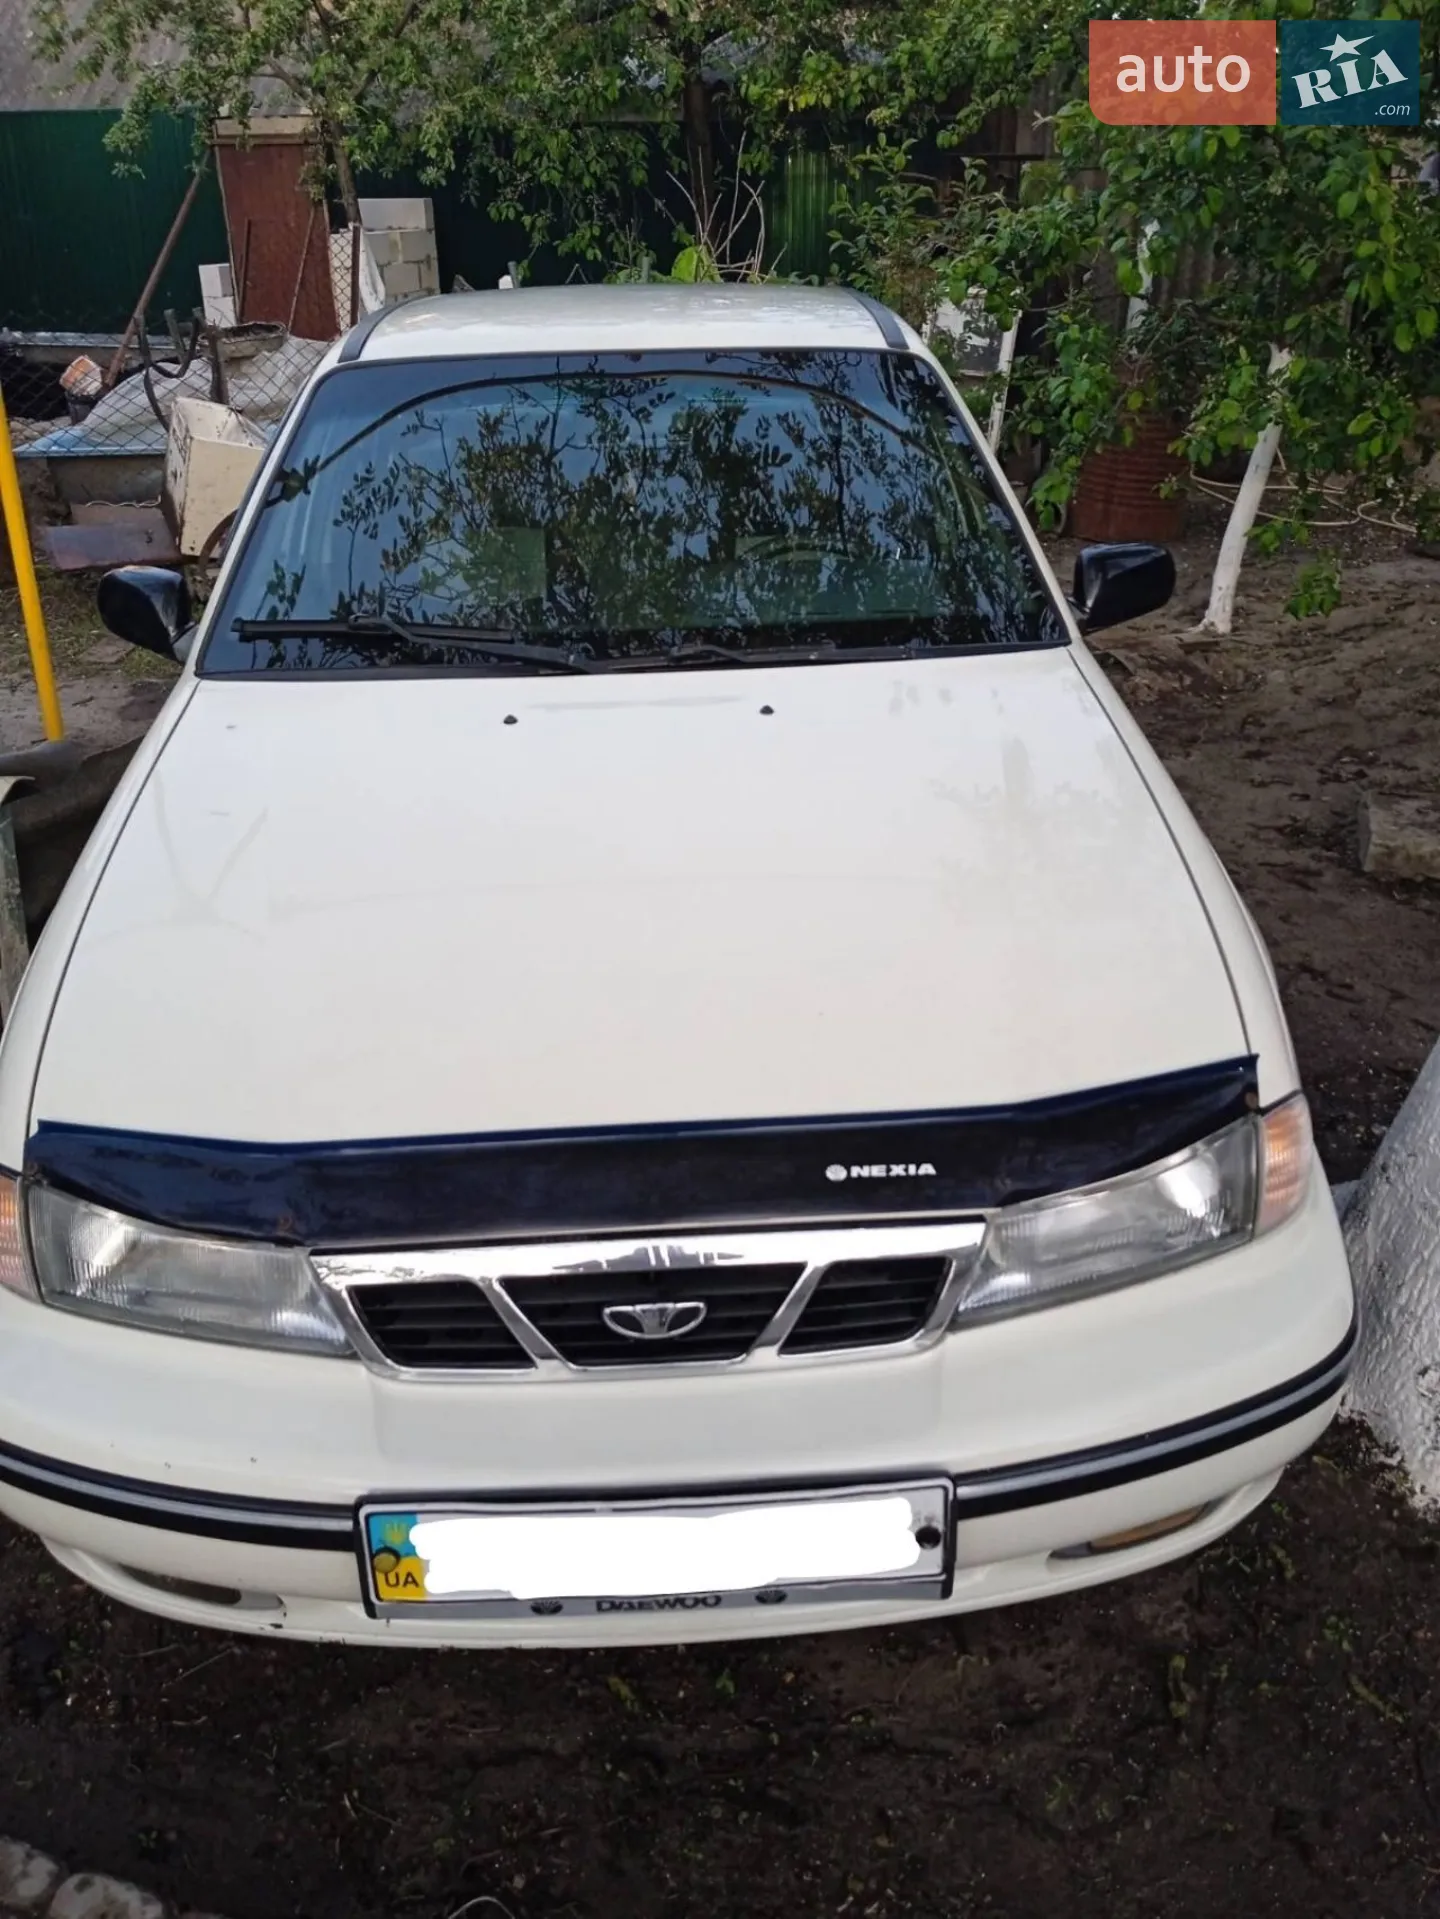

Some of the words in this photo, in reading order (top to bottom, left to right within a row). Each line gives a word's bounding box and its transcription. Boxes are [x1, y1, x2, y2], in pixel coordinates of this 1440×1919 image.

[850, 1163, 937, 1178] NEXIA
[384, 1571, 420, 1588] UA
[596, 1594, 722, 1612] DAEWOO
